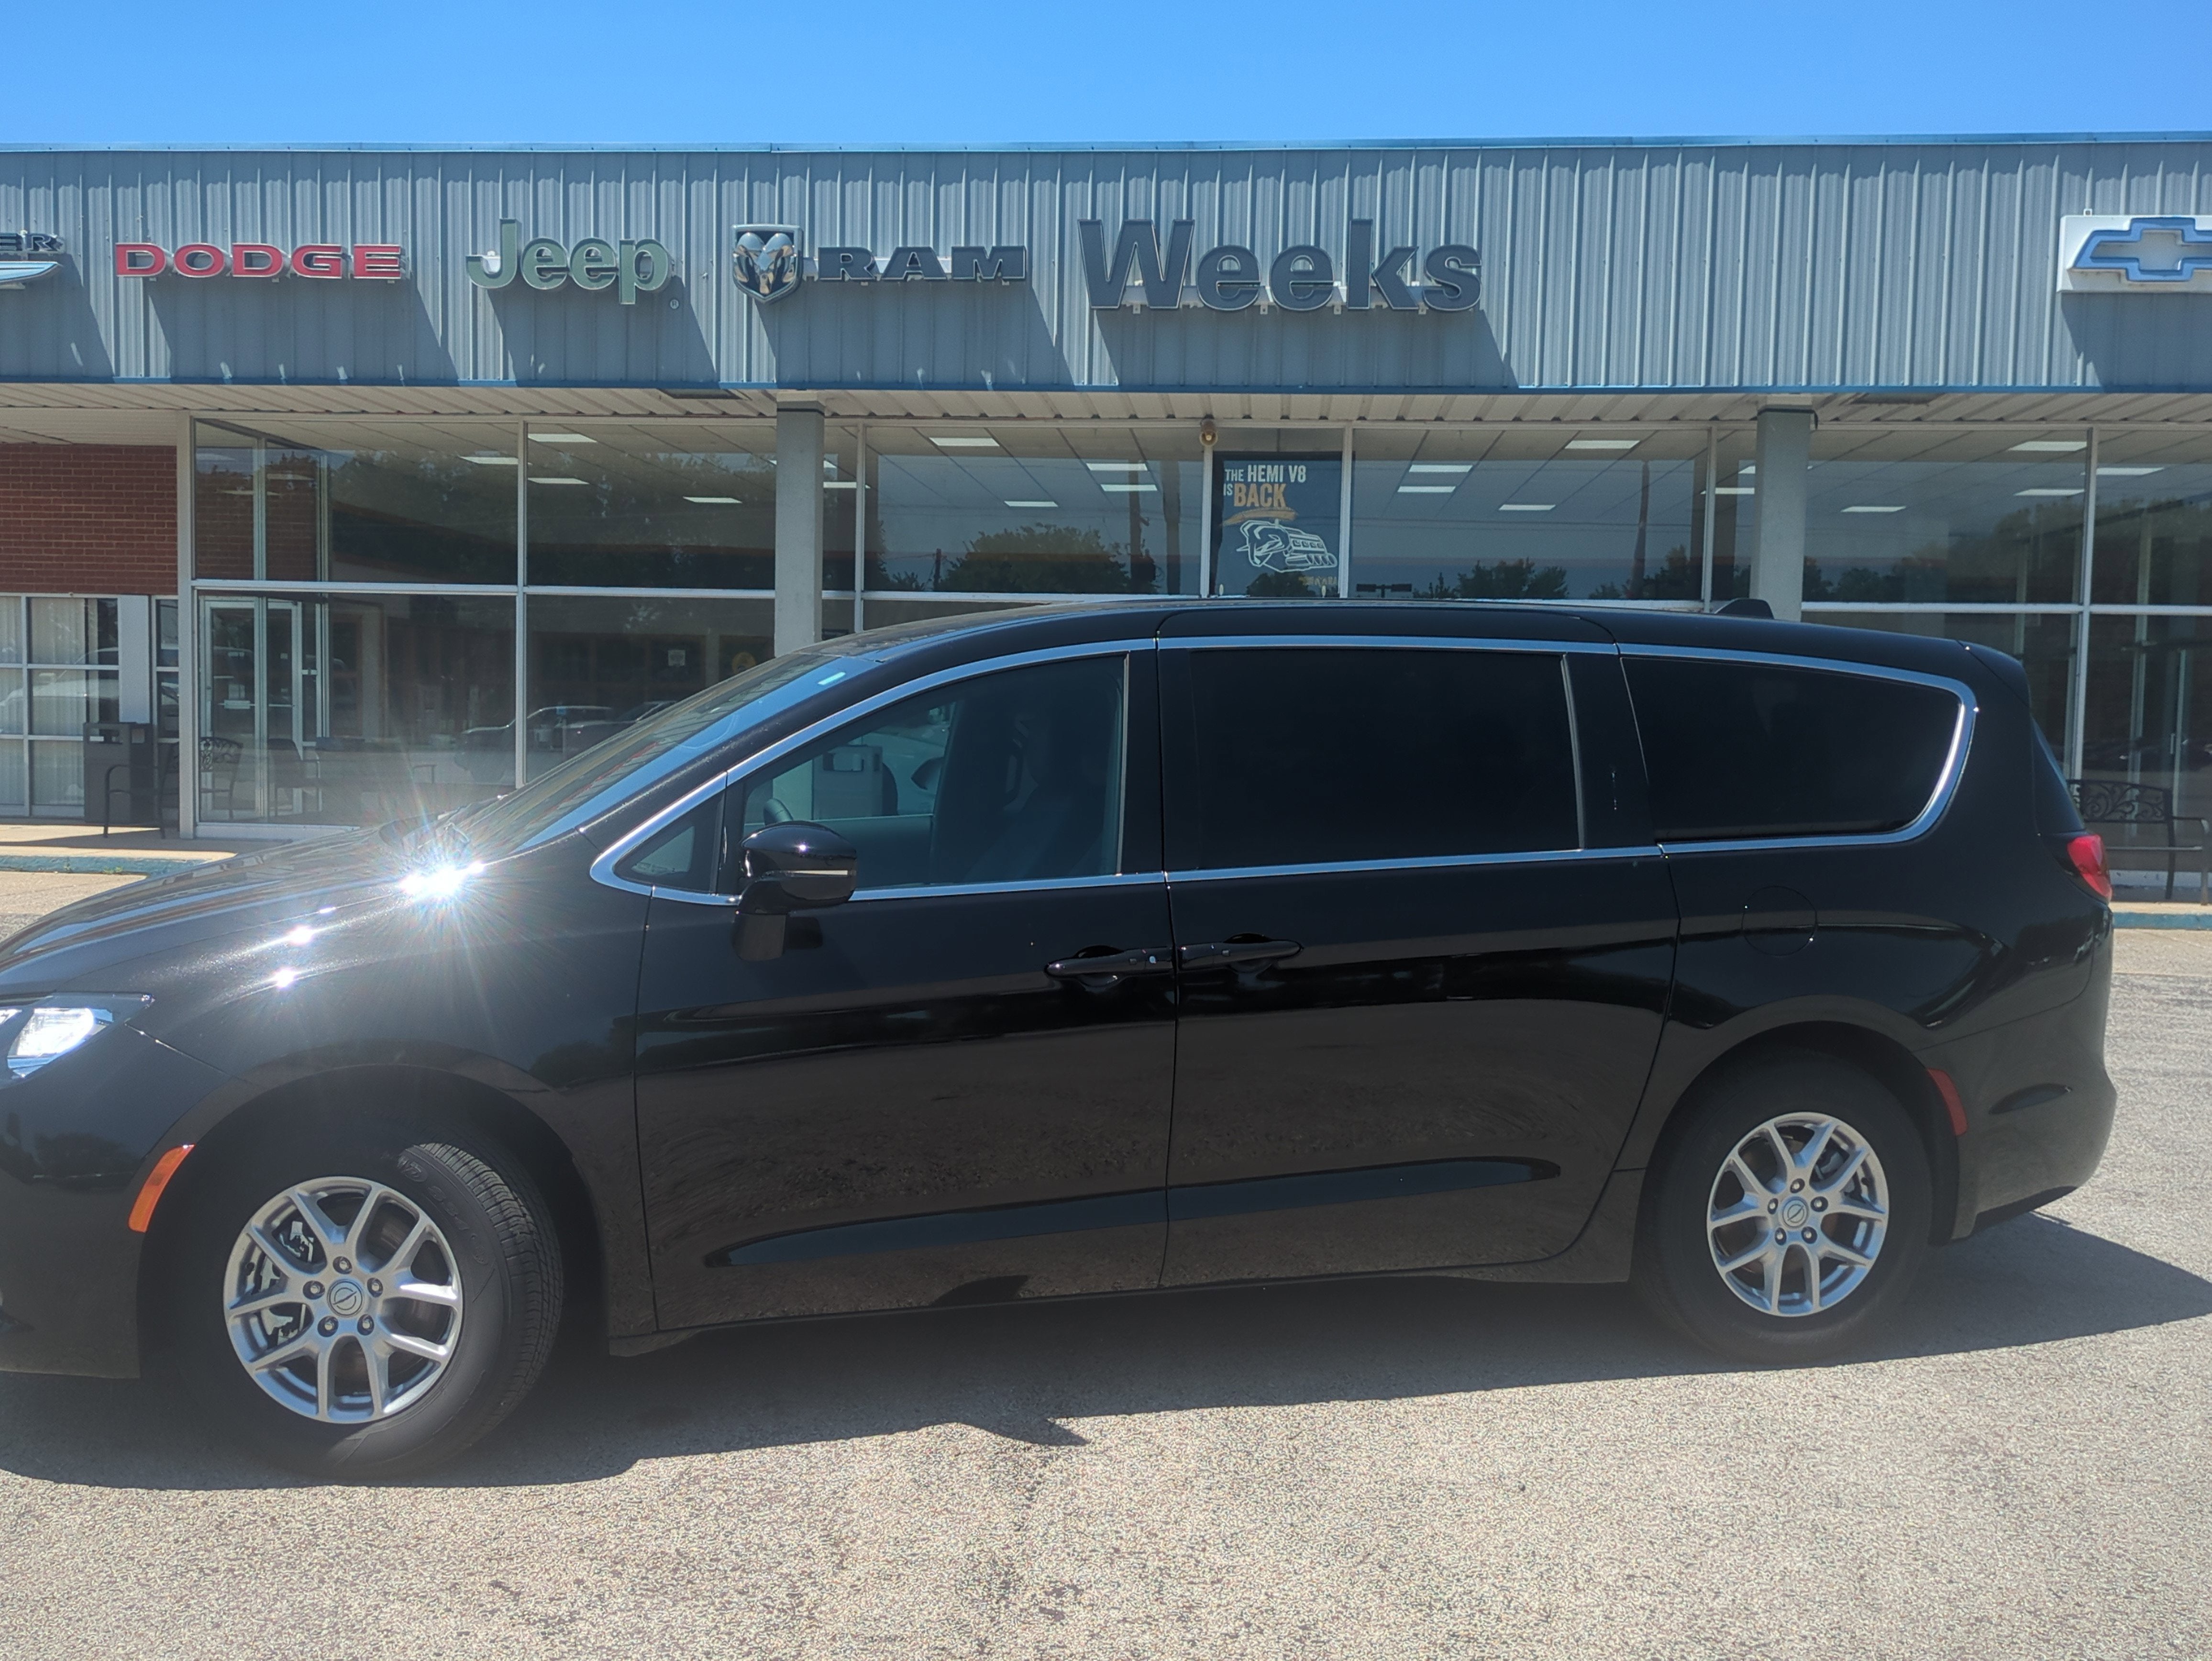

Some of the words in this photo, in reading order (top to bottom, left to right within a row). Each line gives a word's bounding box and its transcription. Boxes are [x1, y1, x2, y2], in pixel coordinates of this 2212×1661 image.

[115, 243, 403, 279] DODGE
[466, 218, 670, 305] Jeep
[818, 246, 1027, 280] RAM
[1077, 219, 1482, 312] Weeks
[1225, 469, 1244, 482] THE
[1248, 465, 1284, 483] HEMI
[1289, 465, 1306, 483] V8
[1223, 483, 1233, 496] IS
[1234, 483, 1287, 508] BACK
